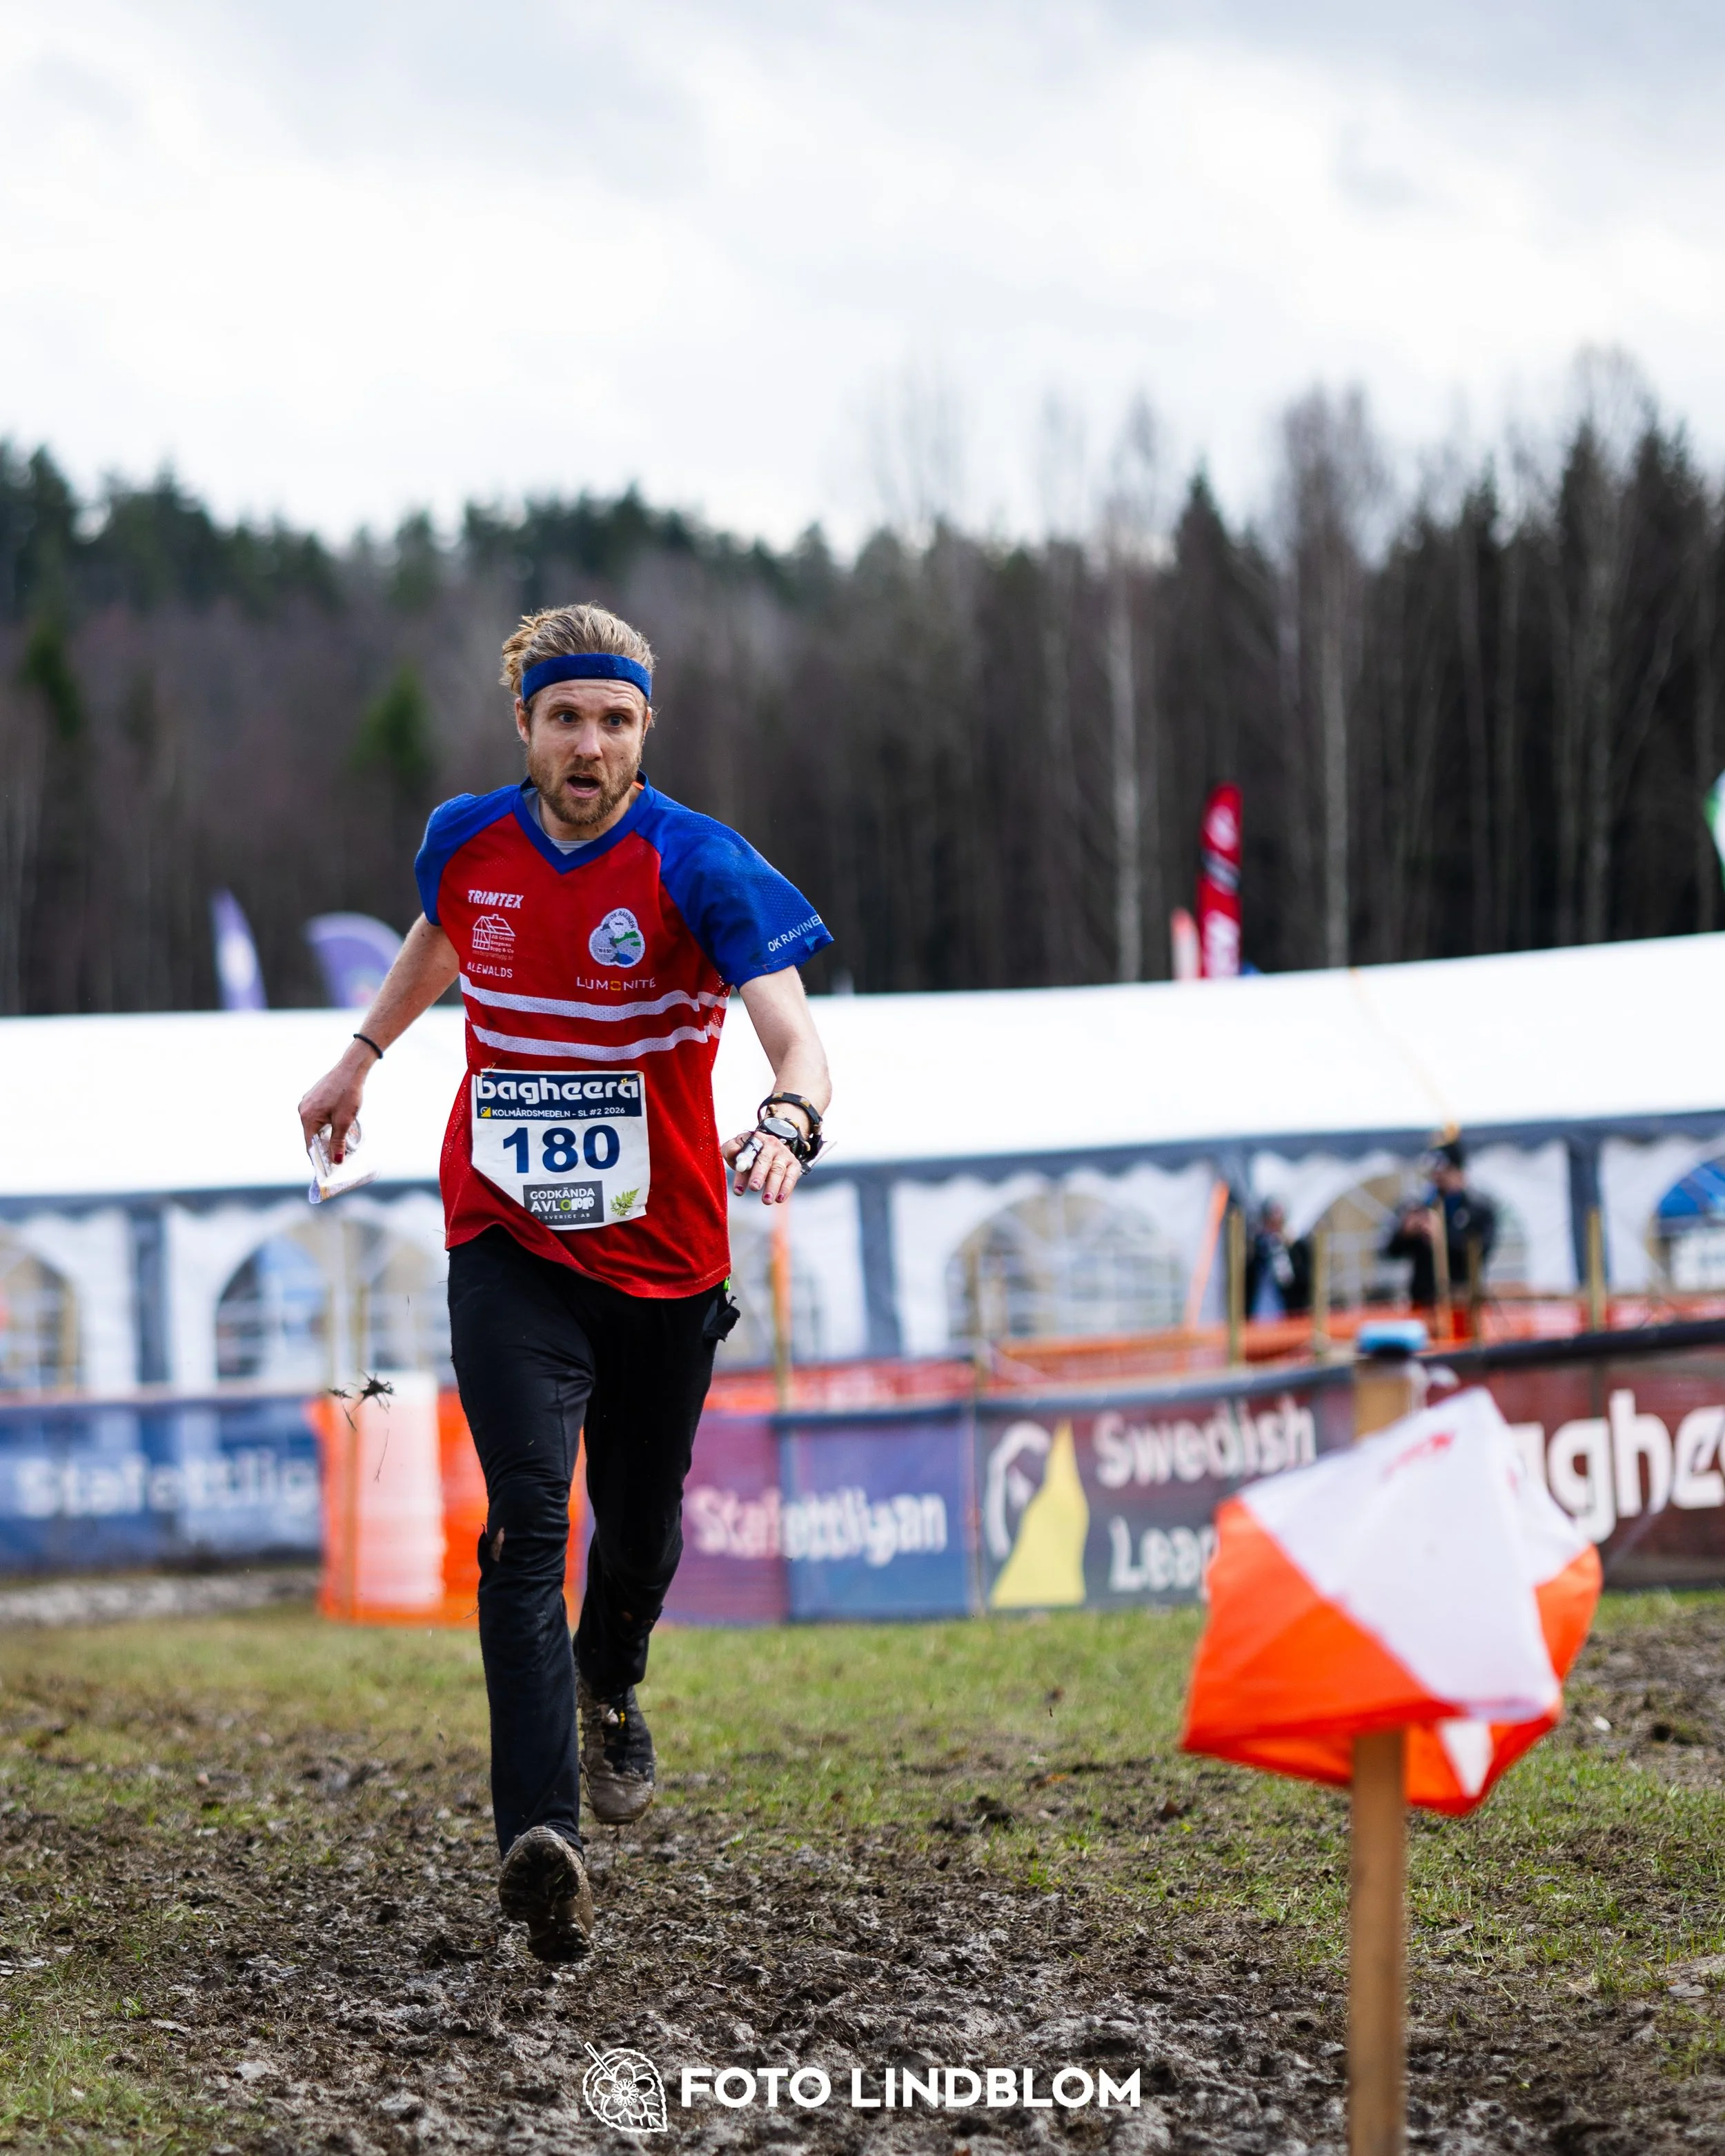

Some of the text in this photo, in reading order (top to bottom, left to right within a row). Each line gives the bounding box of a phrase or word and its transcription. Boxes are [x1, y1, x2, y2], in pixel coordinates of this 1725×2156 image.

[468, 889, 524, 909] TRIMTEX
[767, 914, 823, 952] OK RAVINE
[467, 962, 513, 978] ALEWALDS
[576, 976, 656, 991] LUMONITE
[477, 1077, 638, 1105] bagheera
[492, 1107, 571, 1118] KOLMÅRDSMEDELN
[604, 1107, 625, 1115] 2026
[503, 1124, 620, 1174] 180
[530, 1187, 595, 1200] GODKÄNDA
[1094, 1392, 1317, 1487] Swedish
